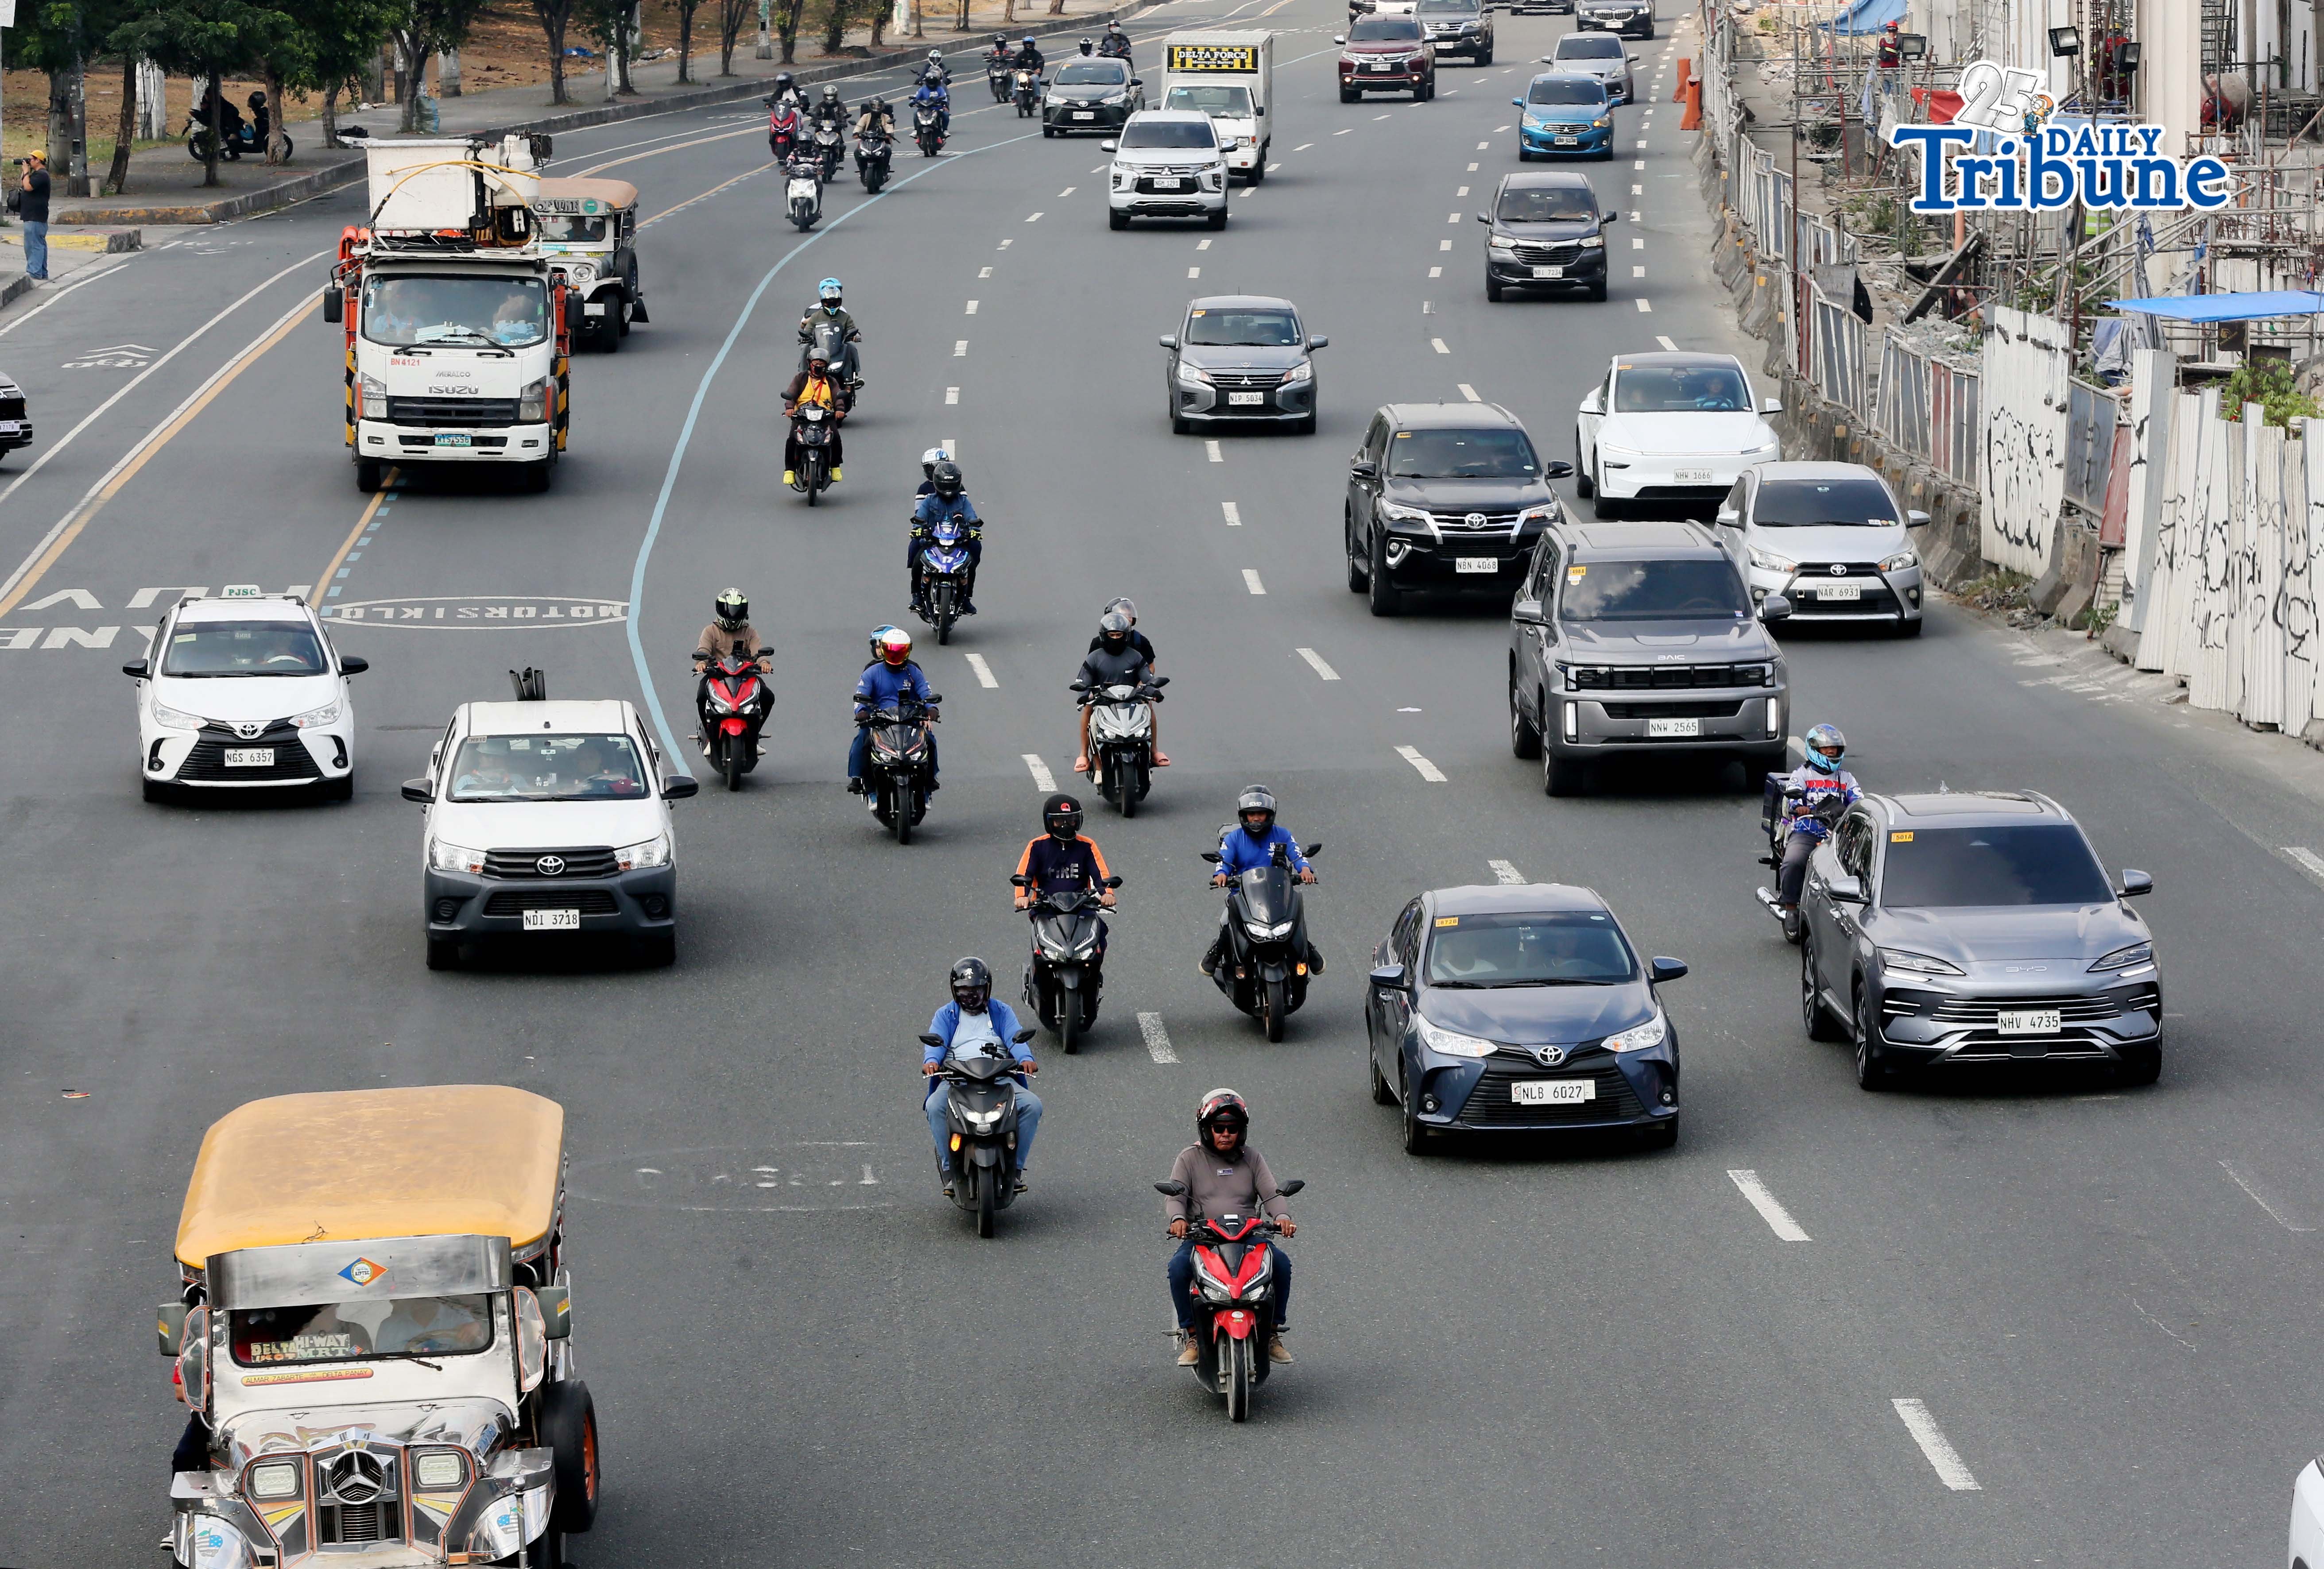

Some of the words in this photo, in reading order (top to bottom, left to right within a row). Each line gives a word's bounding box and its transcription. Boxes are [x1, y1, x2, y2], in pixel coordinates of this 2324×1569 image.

[429, 384, 480, 394] ISUZU
[1457, 562, 1472, 570] NBN
[1818, 588, 1833, 597] NAR
[1839, 588, 1859, 597] 6931
[341, 605, 622, 619] MOTORSIKLO
[1651, 723, 1668, 733] NNW
[1674, 723, 1697, 732] 2565
[227, 753, 243, 762] NGS
[250, 753, 272, 762] 6357
[525, 914, 543, 926] NDI
[552, 914, 577, 925] 3718
[2001, 1017, 2021, 1029] NHV
[2030, 1016, 2058, 1028] 4735
[1523, 1087, 1544, 1099] NLB
[1553, 1086, 1582, 1098] 6027
[295, 1334, 347, 1348] HI-WAY
[252, 1342, 298, 1356] DELTA
[298, 1347, 349, 1358] MRT
